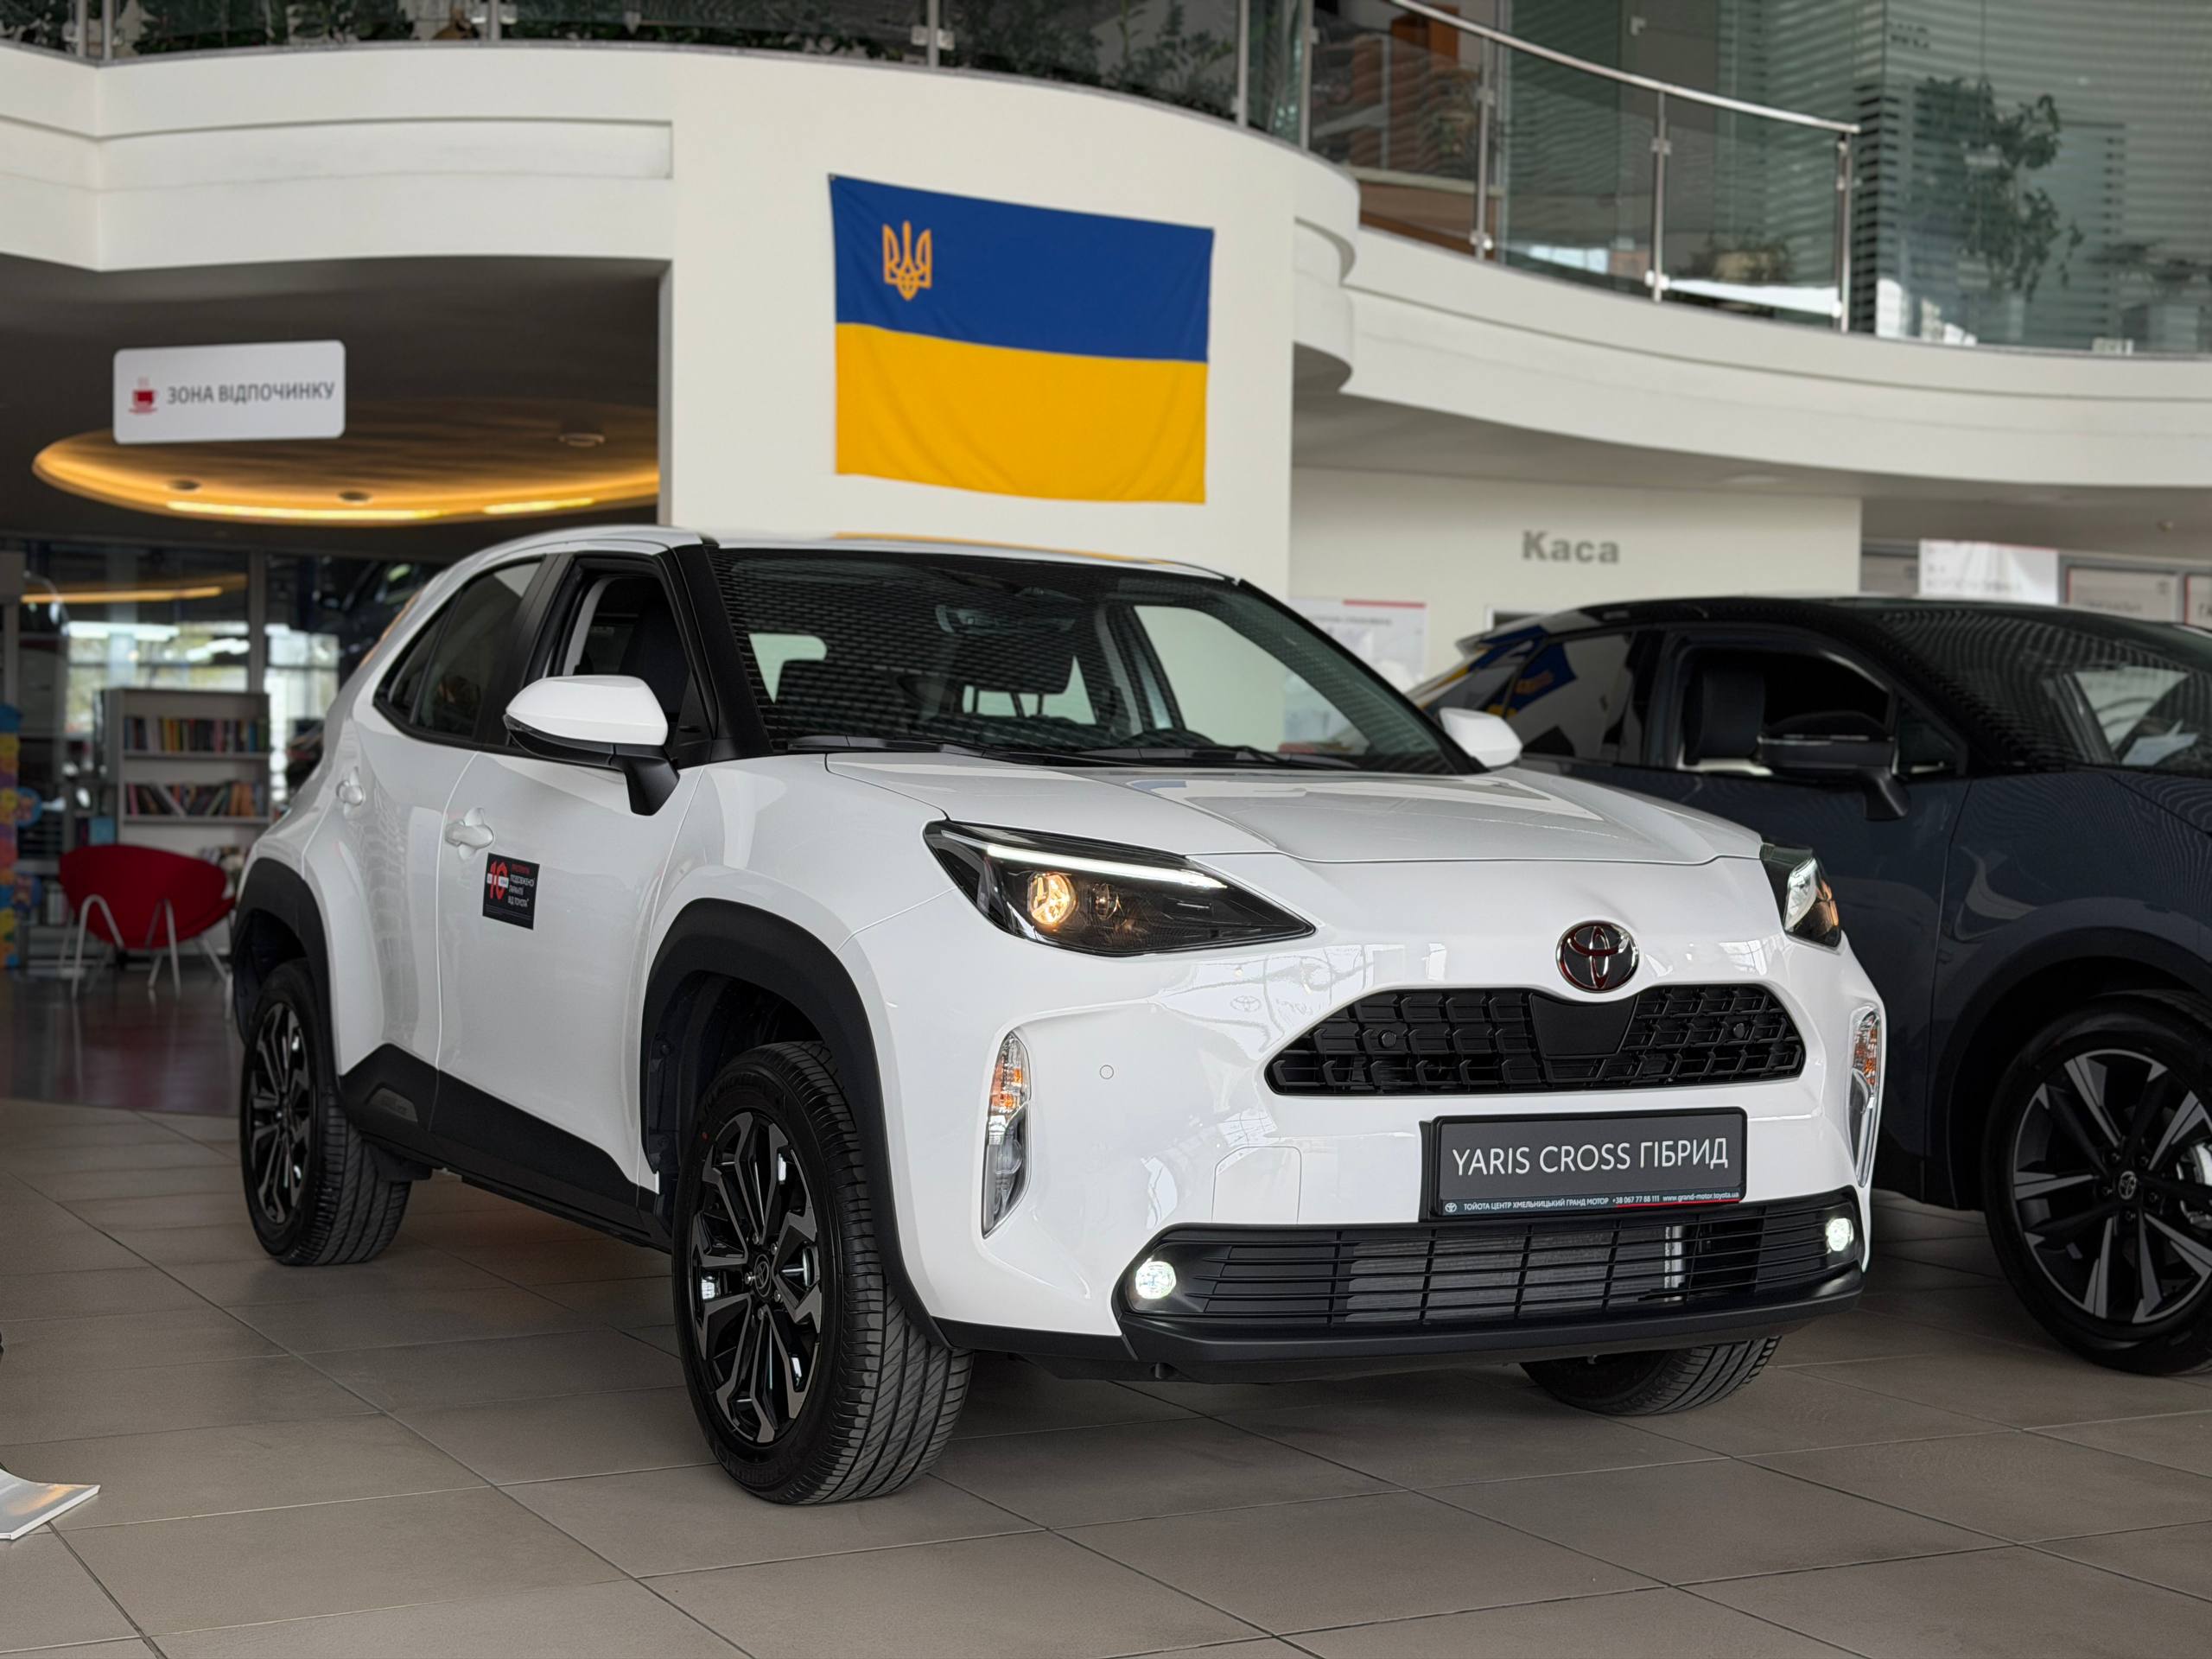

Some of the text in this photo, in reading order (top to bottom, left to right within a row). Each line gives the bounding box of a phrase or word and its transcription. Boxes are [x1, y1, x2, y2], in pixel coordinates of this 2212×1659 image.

[167, 382, 335, 405] ЗОНА ВІДПОЧИНКУ
[1522, 529, 1620, 564] Каса
[1452, 1137, 1729, 1176] YARIS CROSS ГІБРИД
[1463, 1201, 1491, 1211] ТОЙОТА
[1491, 1201, 1512, 1211] ЦЕНТР
[1566, 1198, 1586, 1207] ГРАНД
[1586, 1197, 1609, 1206] МОТОР
